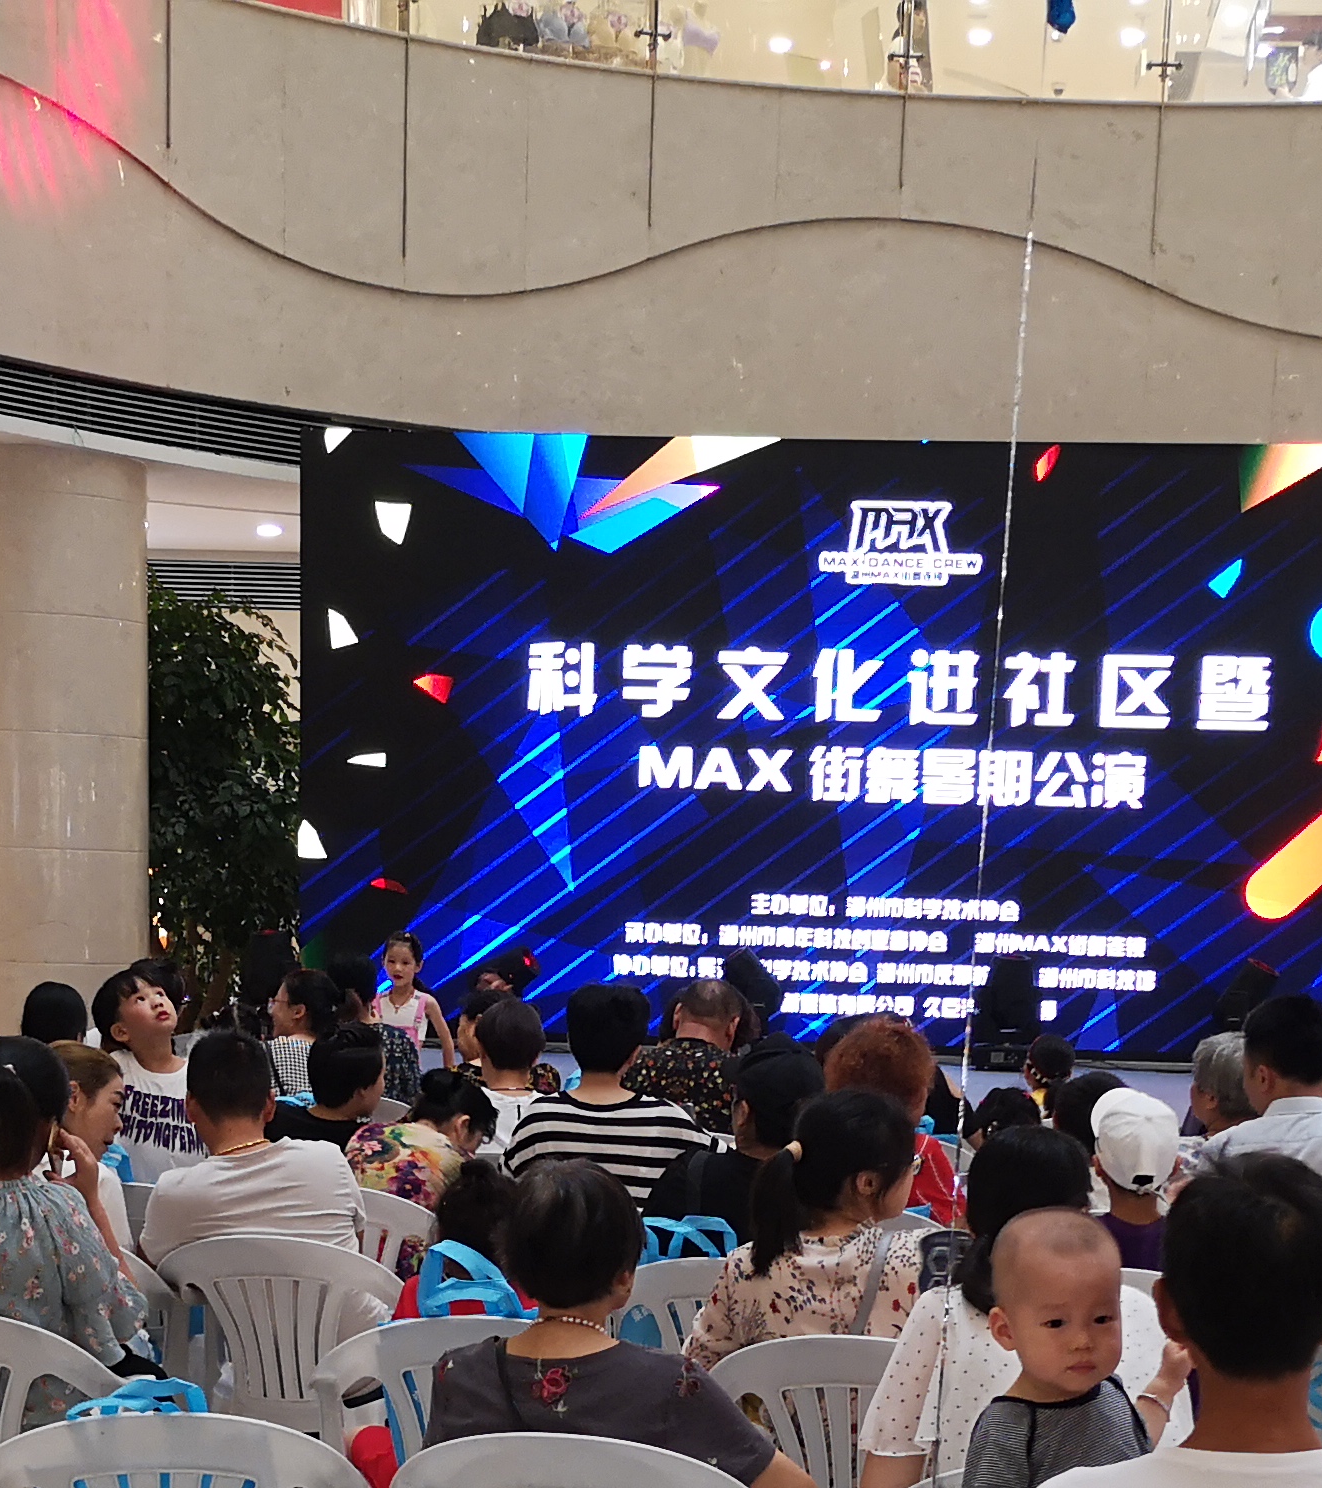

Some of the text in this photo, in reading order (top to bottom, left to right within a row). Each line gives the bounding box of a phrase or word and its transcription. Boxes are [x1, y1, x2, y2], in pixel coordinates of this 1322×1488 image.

[527, 640, 1273, 732] 科学文化进社区暨
[638, 744, 1149, 810] MAX 街舞暑期公演
